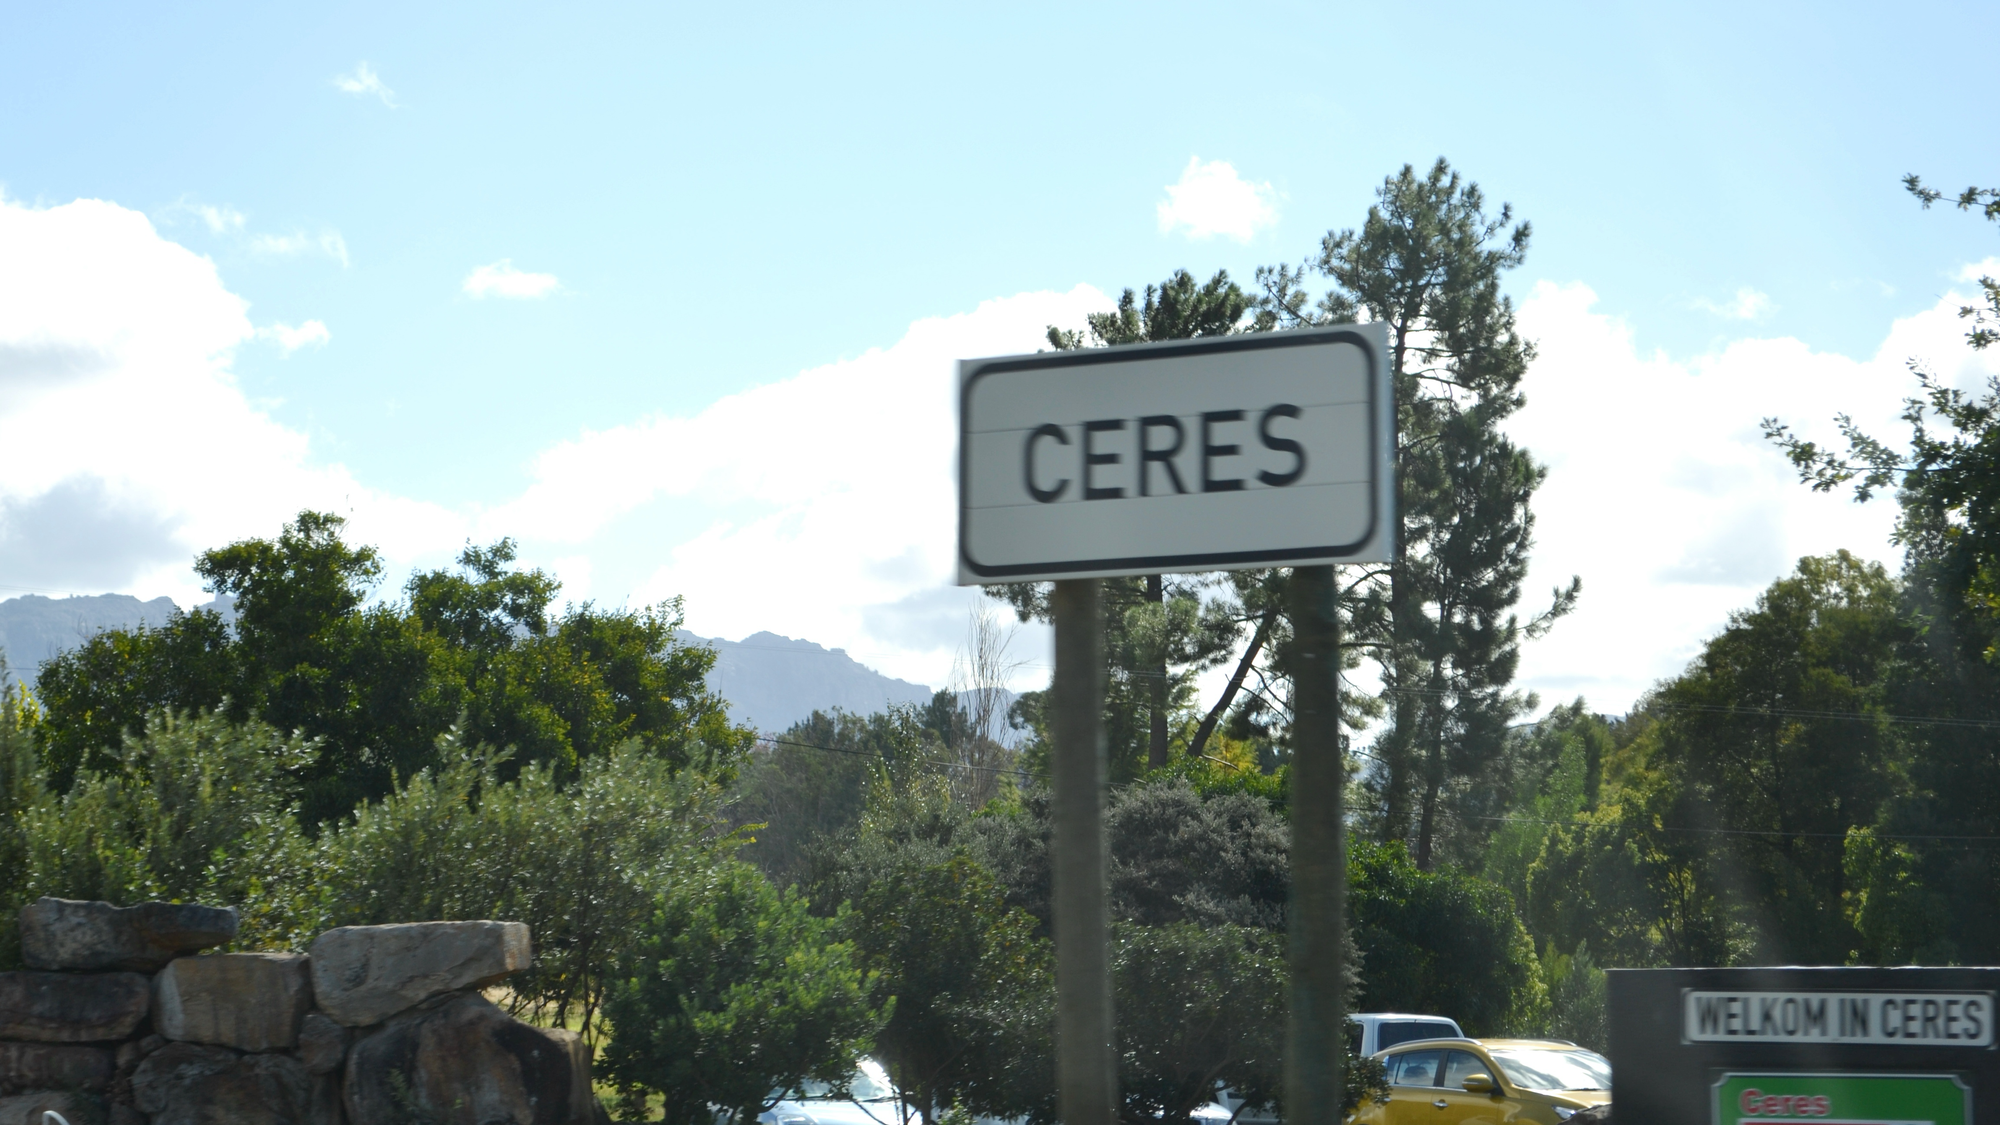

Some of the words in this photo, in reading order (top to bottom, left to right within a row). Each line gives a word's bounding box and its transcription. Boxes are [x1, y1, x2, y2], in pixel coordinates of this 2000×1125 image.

[1024, 403, 1307, 503] CERES
[1695, 996, 1828, 1037] WELKOM
[1838, 997, 1870, 1038] IN
[1880, 998, 1985, 1040] CERES
[1739, 1088, 1832, 1117] Ceres
